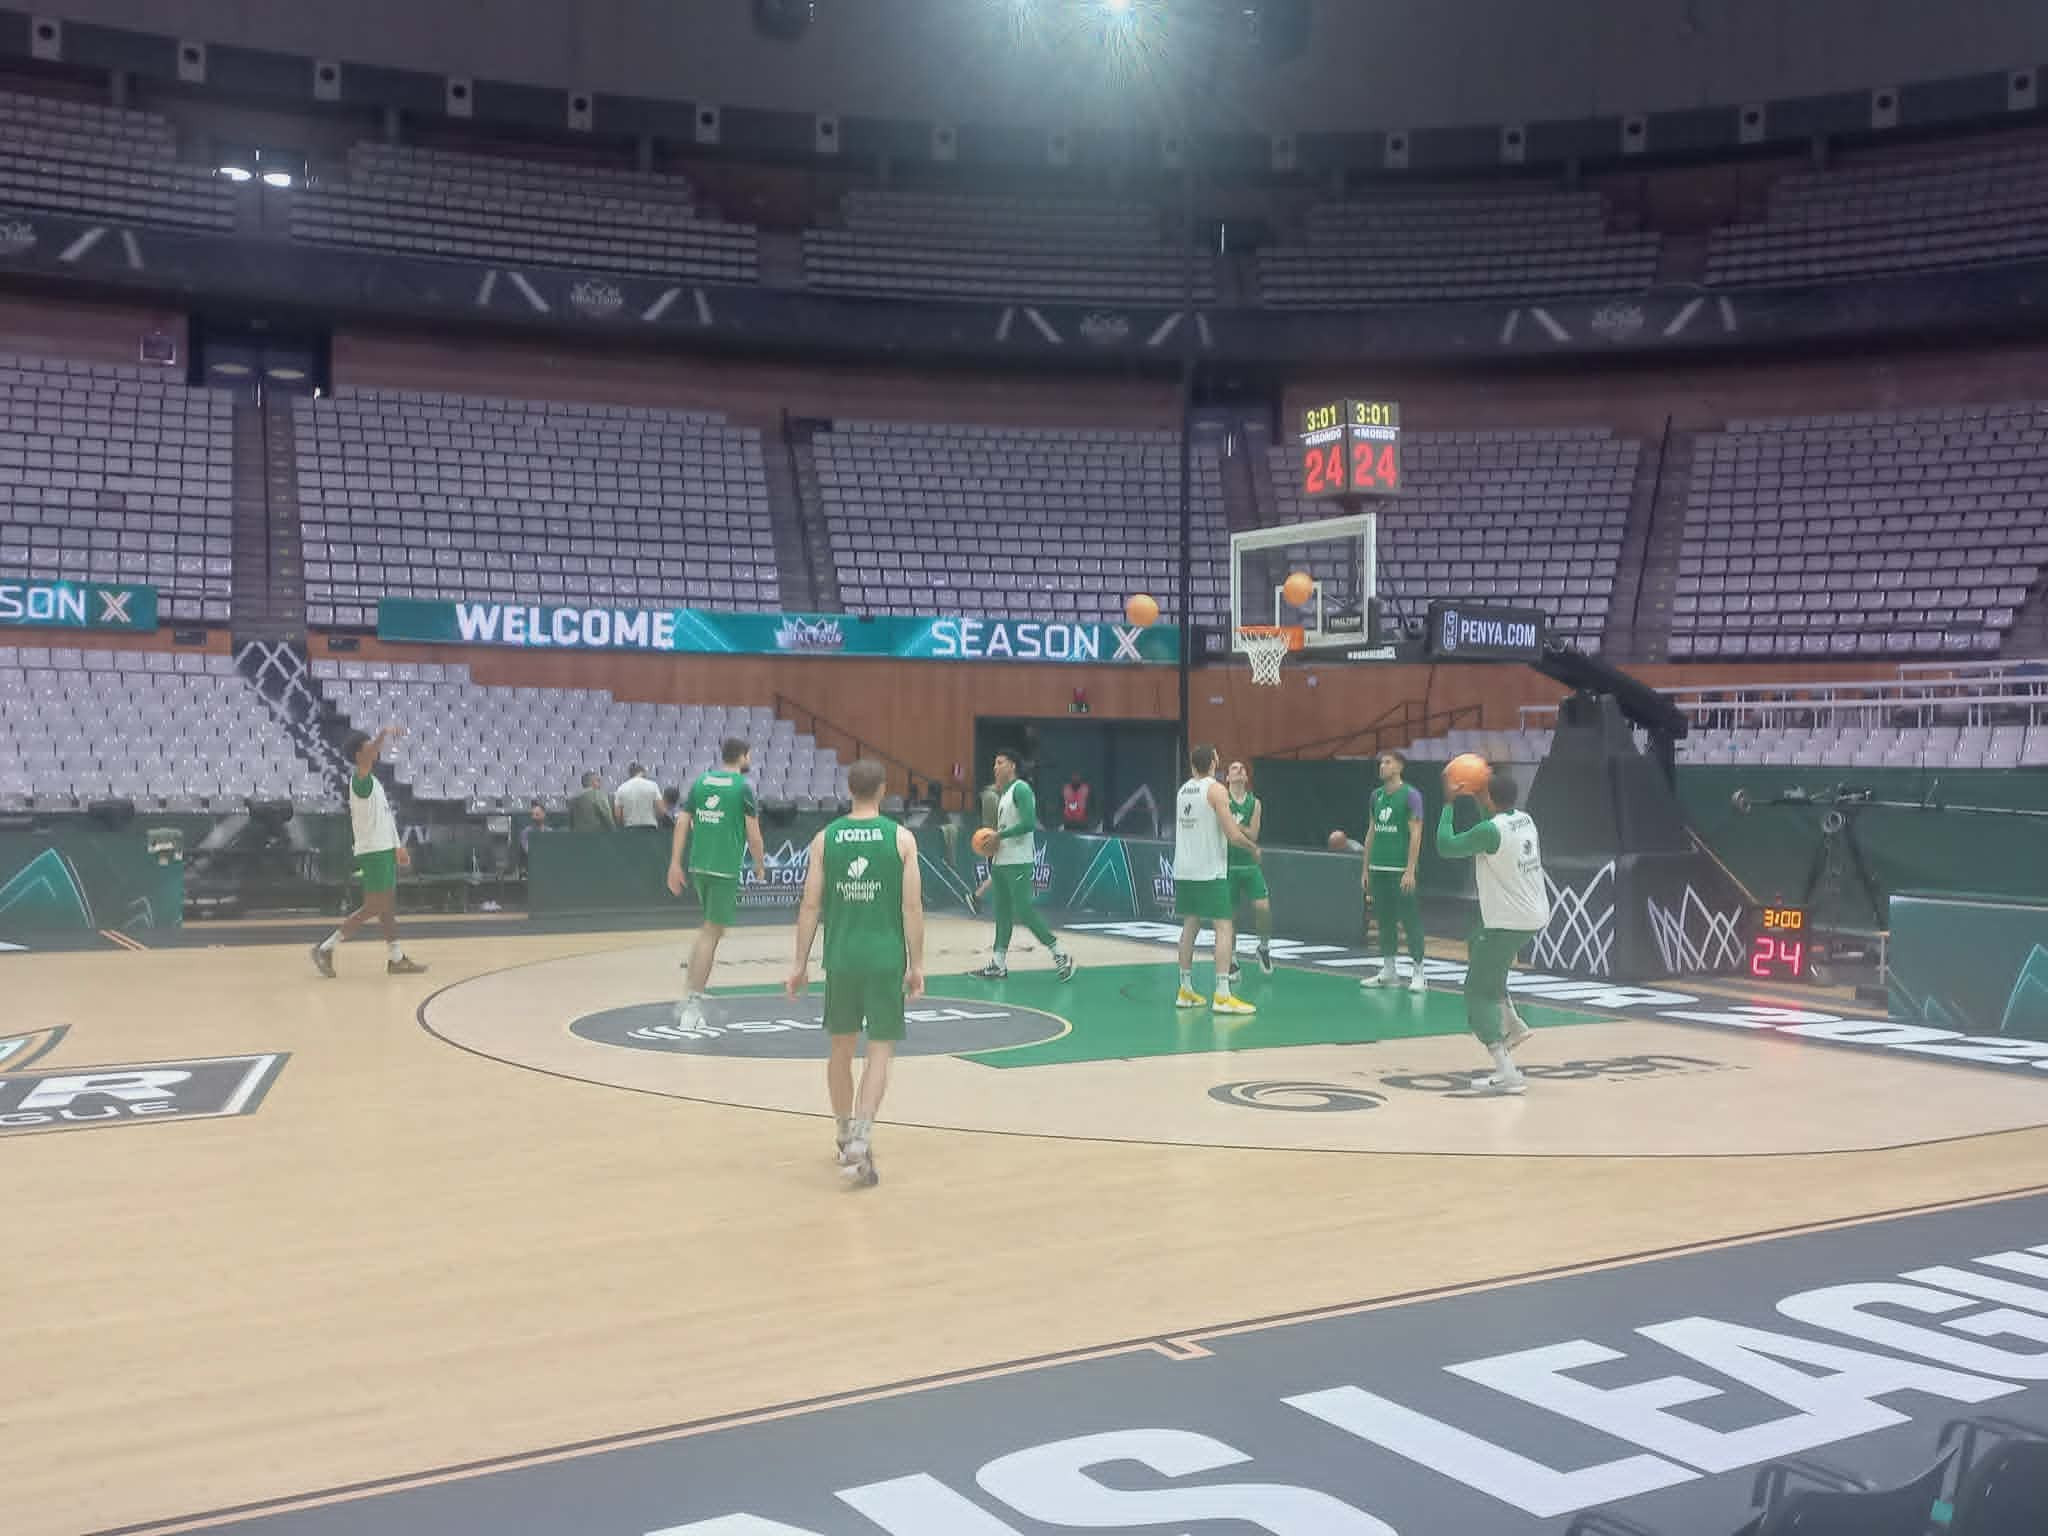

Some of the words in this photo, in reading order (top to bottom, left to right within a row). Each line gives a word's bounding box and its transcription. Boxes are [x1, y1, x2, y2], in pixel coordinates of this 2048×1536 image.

[1307, 405, 1336, 431] 3:01
[1356, 403, 1390, 425] 3:01
[1304, 447, 1344, 494] 24
[1354, 443, 1398, 488] 24
[99, 590, 131, 622] X
[455, 602, 675, 650] WELCOME
[931, 621, 1099, 659] SEASON
[1112, 626, 1144, 661] X
[1461, 617, 1536, 648] PENYA.COM
[1763, 908, 1802, 929] 3:00
[1752, 937, 1802, 975] 24
[1656, 1005, 2048, 1074] 202
